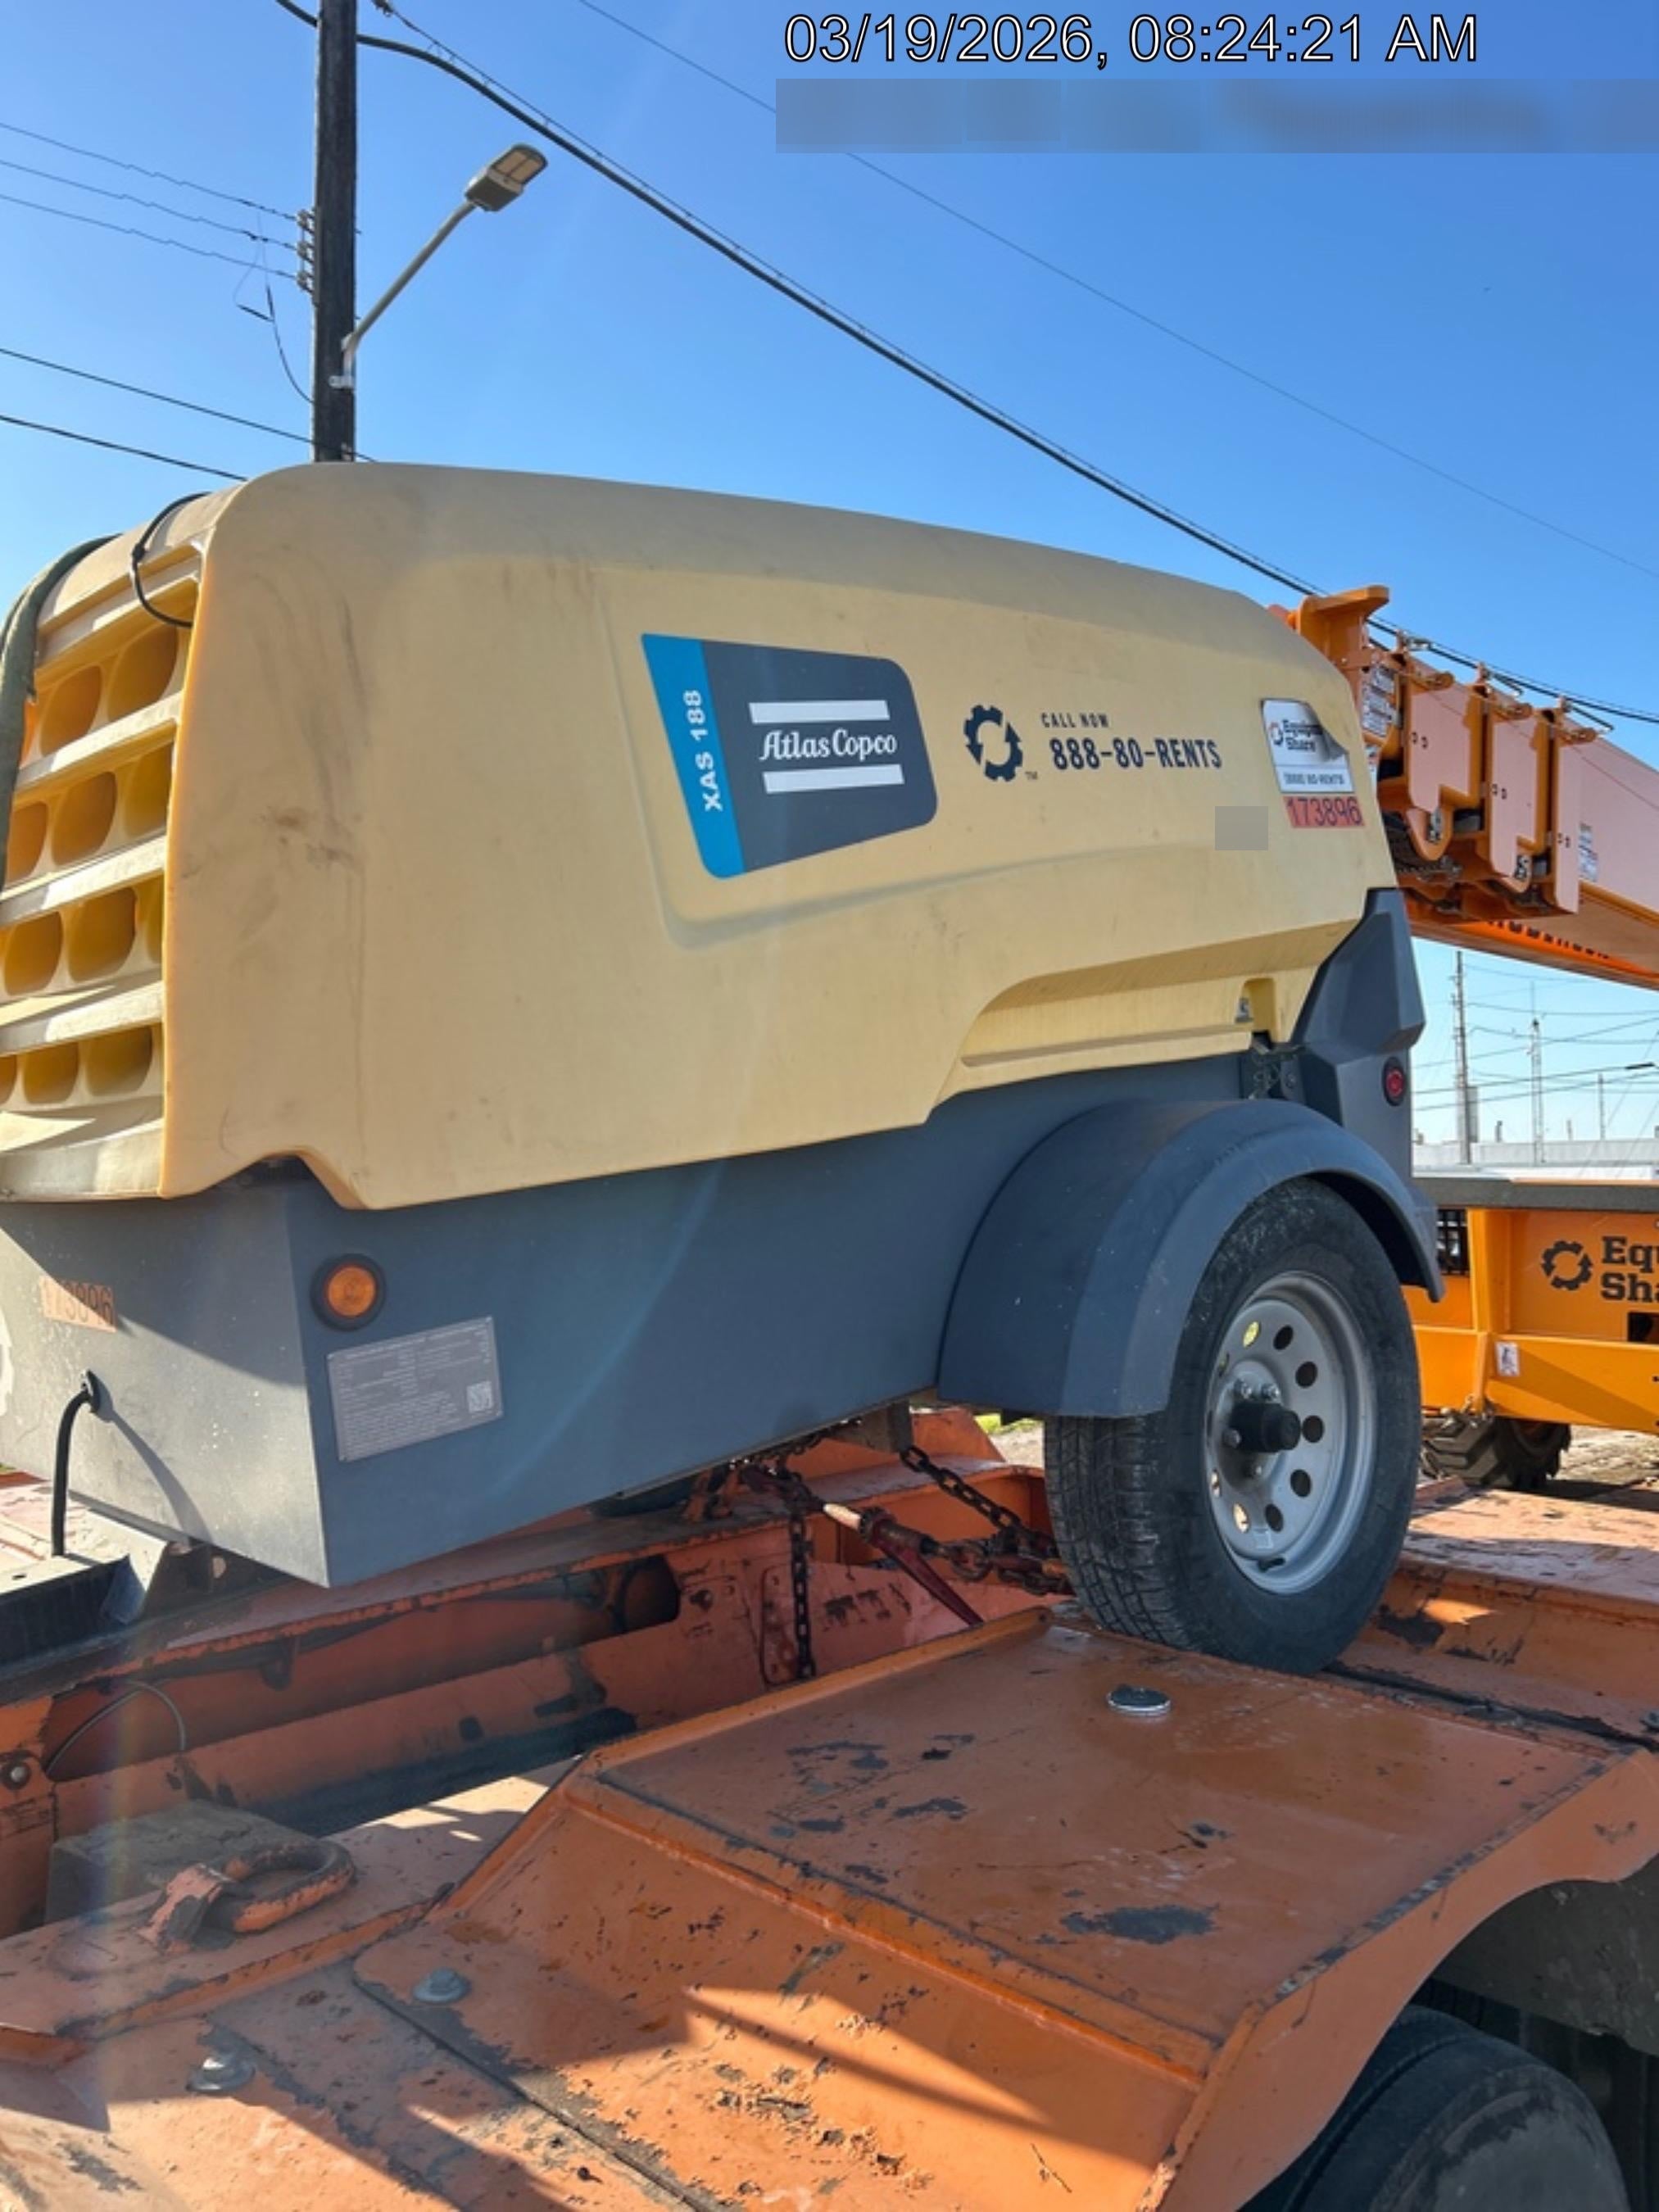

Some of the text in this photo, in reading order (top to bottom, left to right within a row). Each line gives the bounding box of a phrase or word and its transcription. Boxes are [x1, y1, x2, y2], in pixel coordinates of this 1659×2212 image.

[1041, 712, 1109, 728] CALL NOW
[682, 689, 723, 812] XAS 188
[1049, 737, 1222, 770] 888-80-RENTS
[1285, 796, 1362, 827] 173896
[1601, 1235, 1659, 1273] Eq
